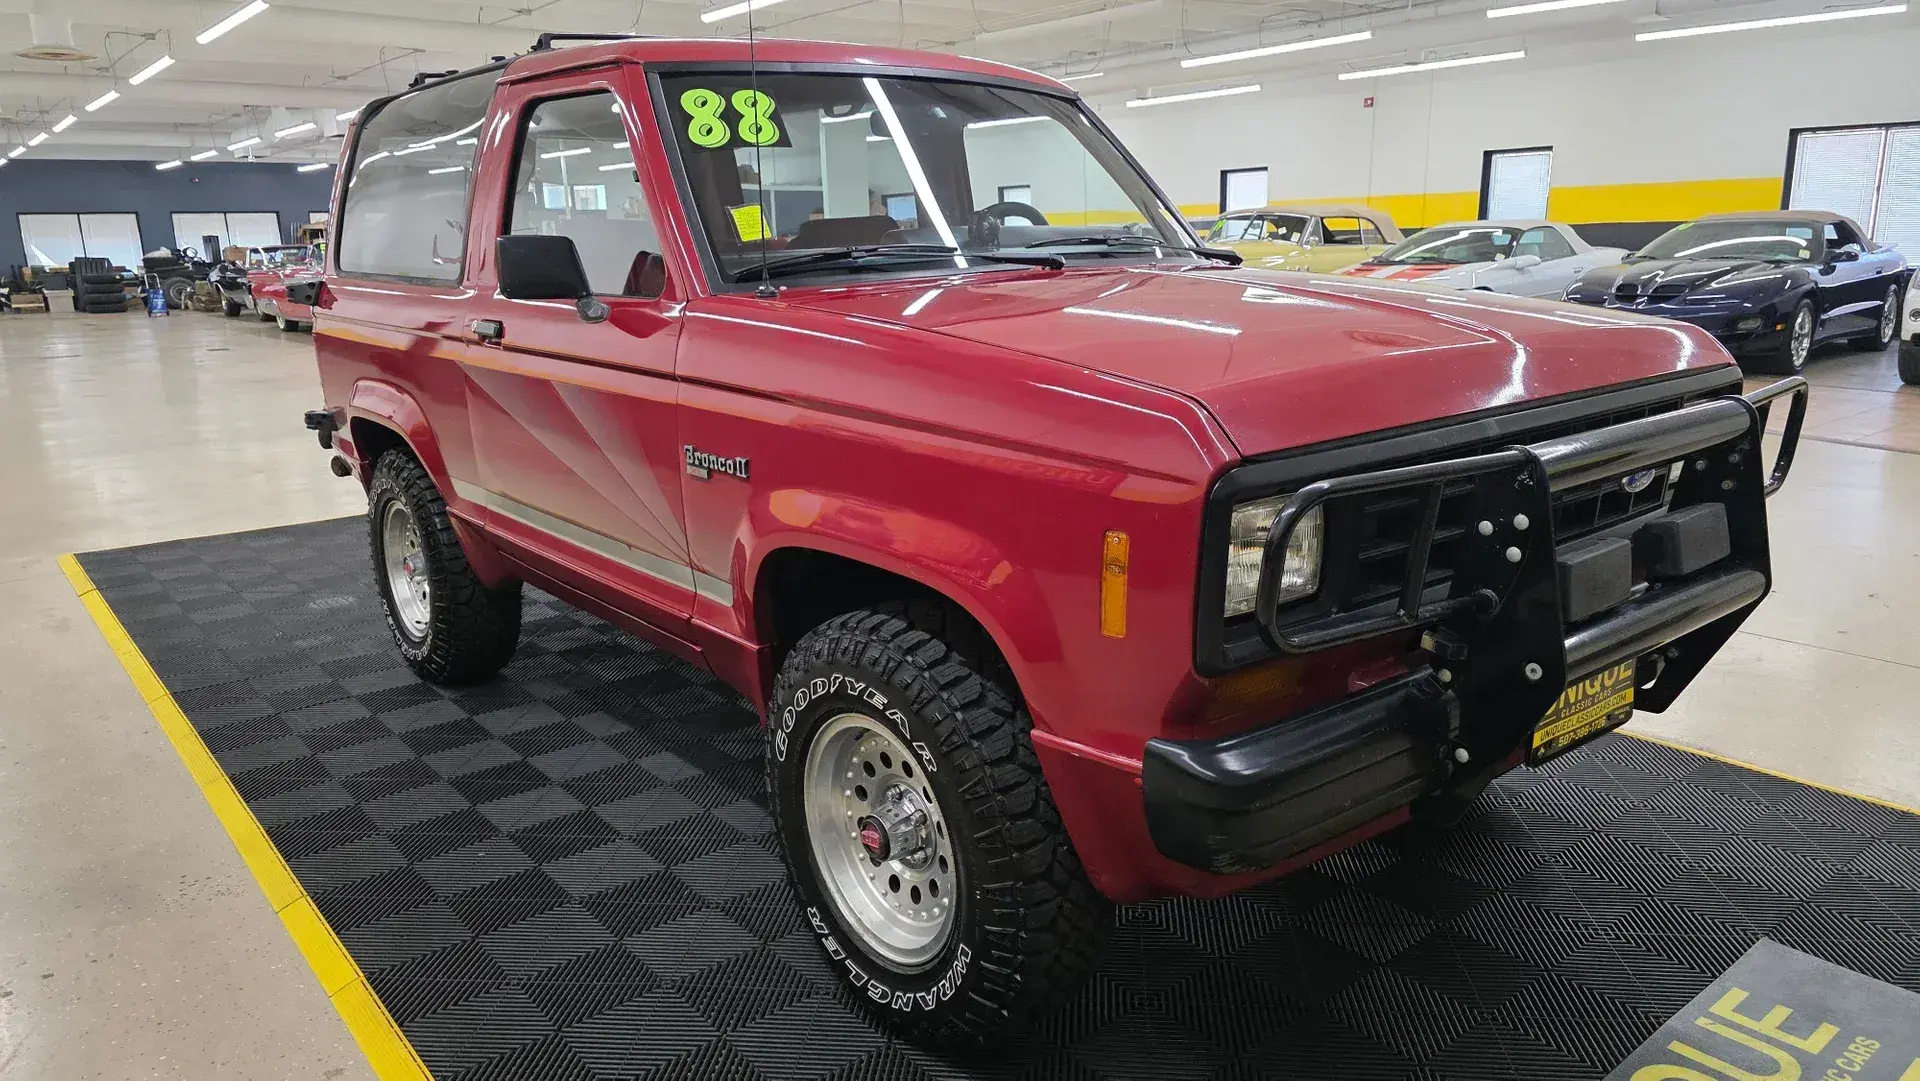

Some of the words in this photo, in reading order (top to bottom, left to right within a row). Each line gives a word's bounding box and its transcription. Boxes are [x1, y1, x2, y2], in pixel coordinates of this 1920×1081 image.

[680, 88, 780, 147] 88
[684, 444, 734, 474] Bronco
[1545, 662, 1632, 715] NIQUE
[1561, 699, 1592, 717] CLASSIC
[1594, 688, 1612, 704] CARS
[776, 673, 937, 772] GOODYEAR
[807, 906, 971, 1011] WRANGLER
[1835, 1036, 1881, 1072] CARS
